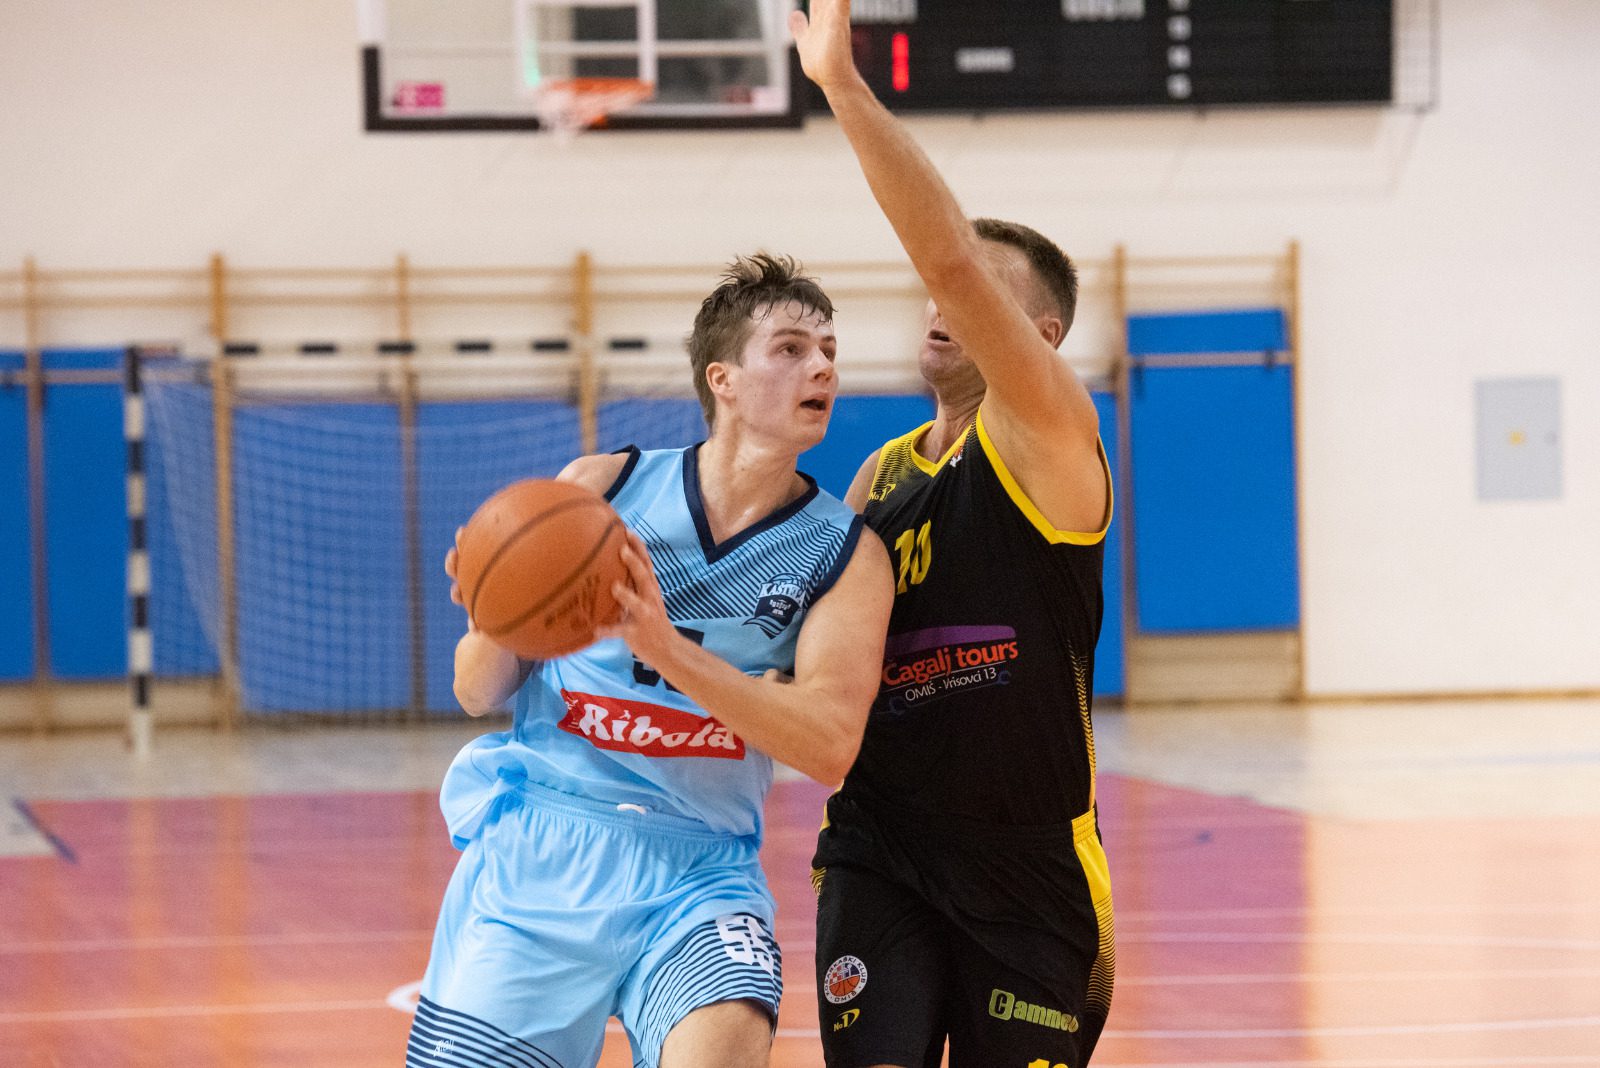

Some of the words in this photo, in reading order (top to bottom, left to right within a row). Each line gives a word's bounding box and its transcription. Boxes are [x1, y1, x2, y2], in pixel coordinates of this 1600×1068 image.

[894, 519, 932, 595] 10
[956, 641, 1019, 668] tours
[905, 680, 936, 702] OMIŠ
[943, 671, 982, 690] Vrisovci
[984, 667, 997, 680] 13
[579, 703, 737, 750] Ribola
